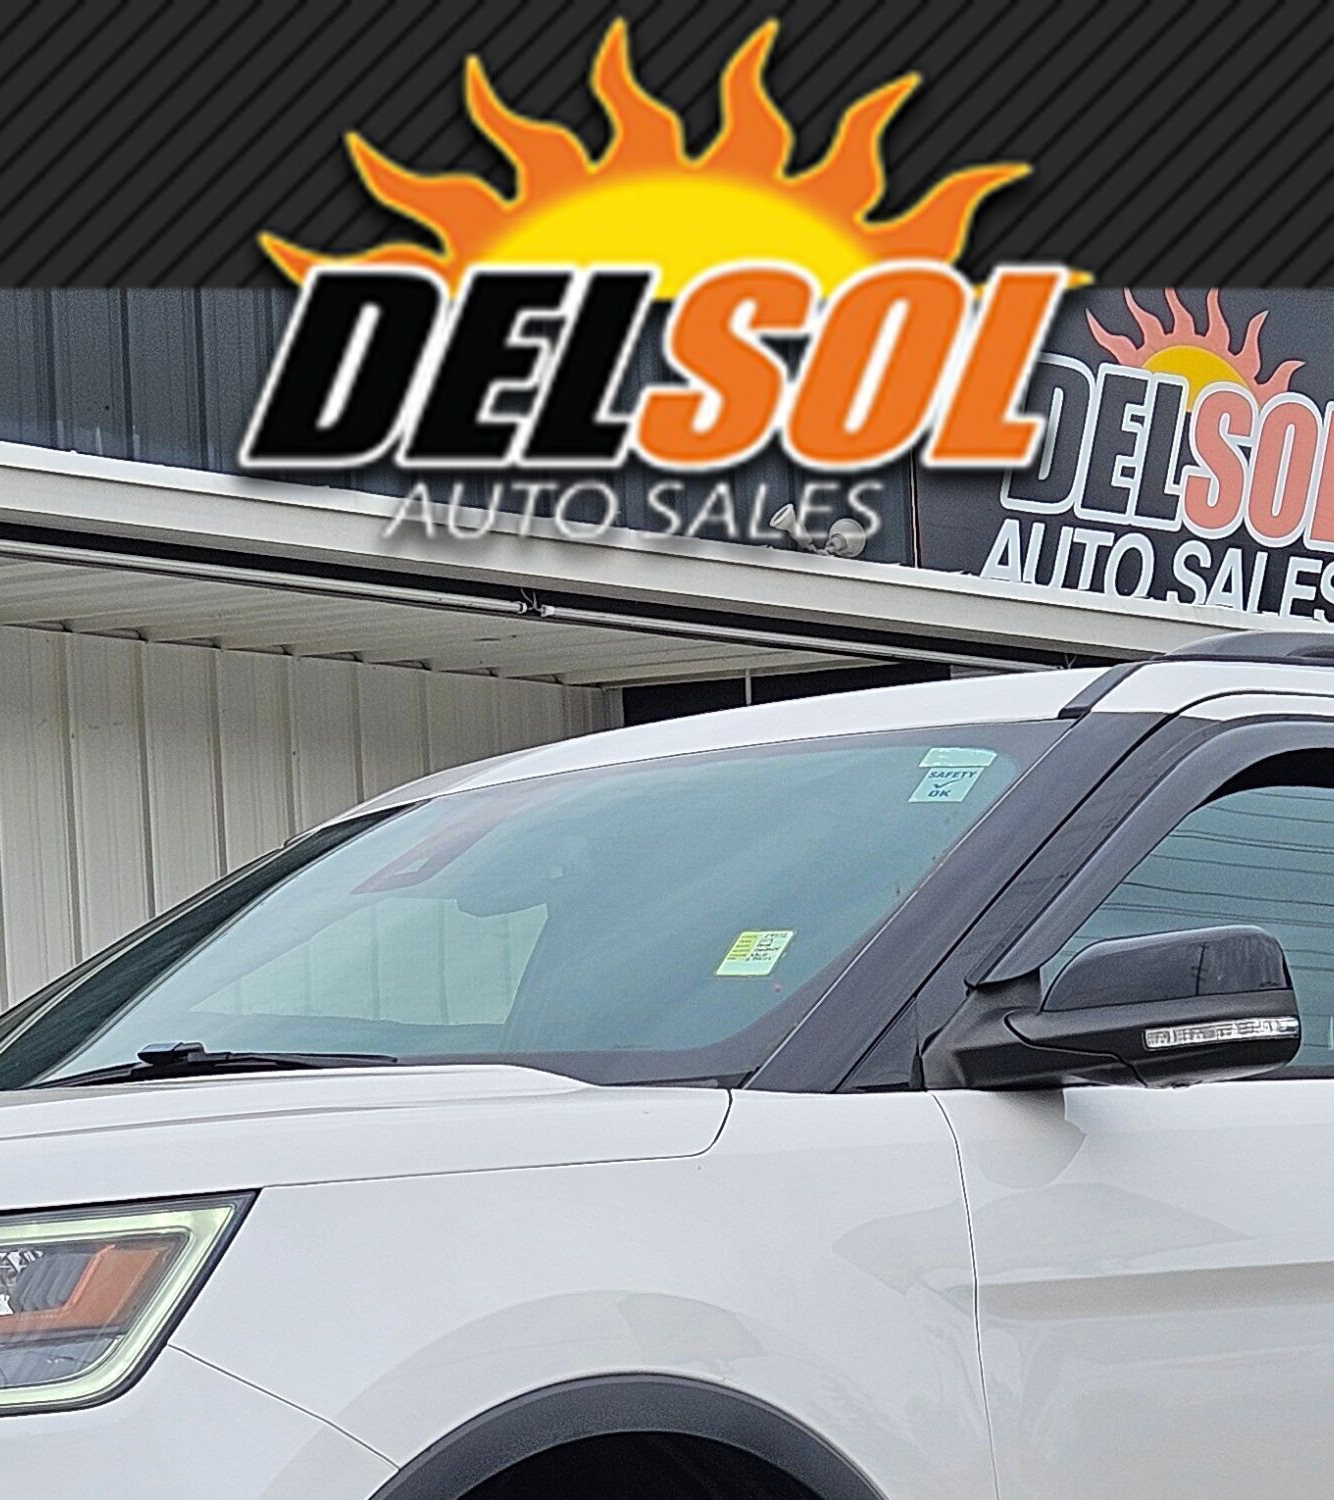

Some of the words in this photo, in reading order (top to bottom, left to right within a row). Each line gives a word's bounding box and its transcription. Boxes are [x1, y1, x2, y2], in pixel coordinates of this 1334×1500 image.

[981, 519, 1155, 600] AUTO
[928, 771, 978, 779] SAFETY
[928, 789, 951, 798] OK
